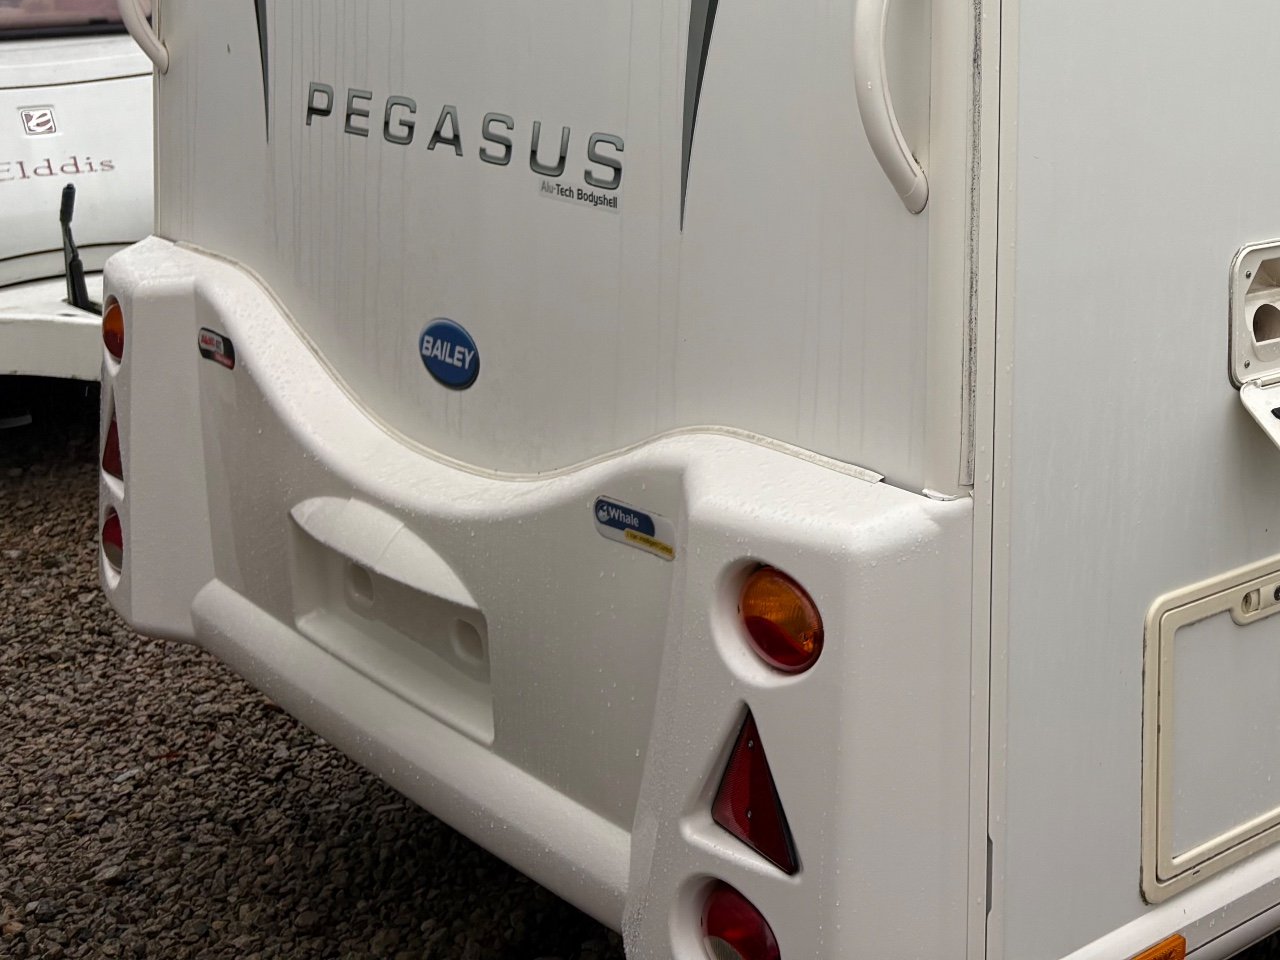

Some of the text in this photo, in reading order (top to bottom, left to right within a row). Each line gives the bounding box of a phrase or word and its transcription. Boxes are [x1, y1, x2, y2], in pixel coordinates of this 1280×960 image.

[305, 81, 625, 191] PEGASUS
[540, 180, 618, 209] Alu-Tech Bodyshell
[422, 334, 476, 370] BAILEY
[608, 505, 640, 528] Whale
